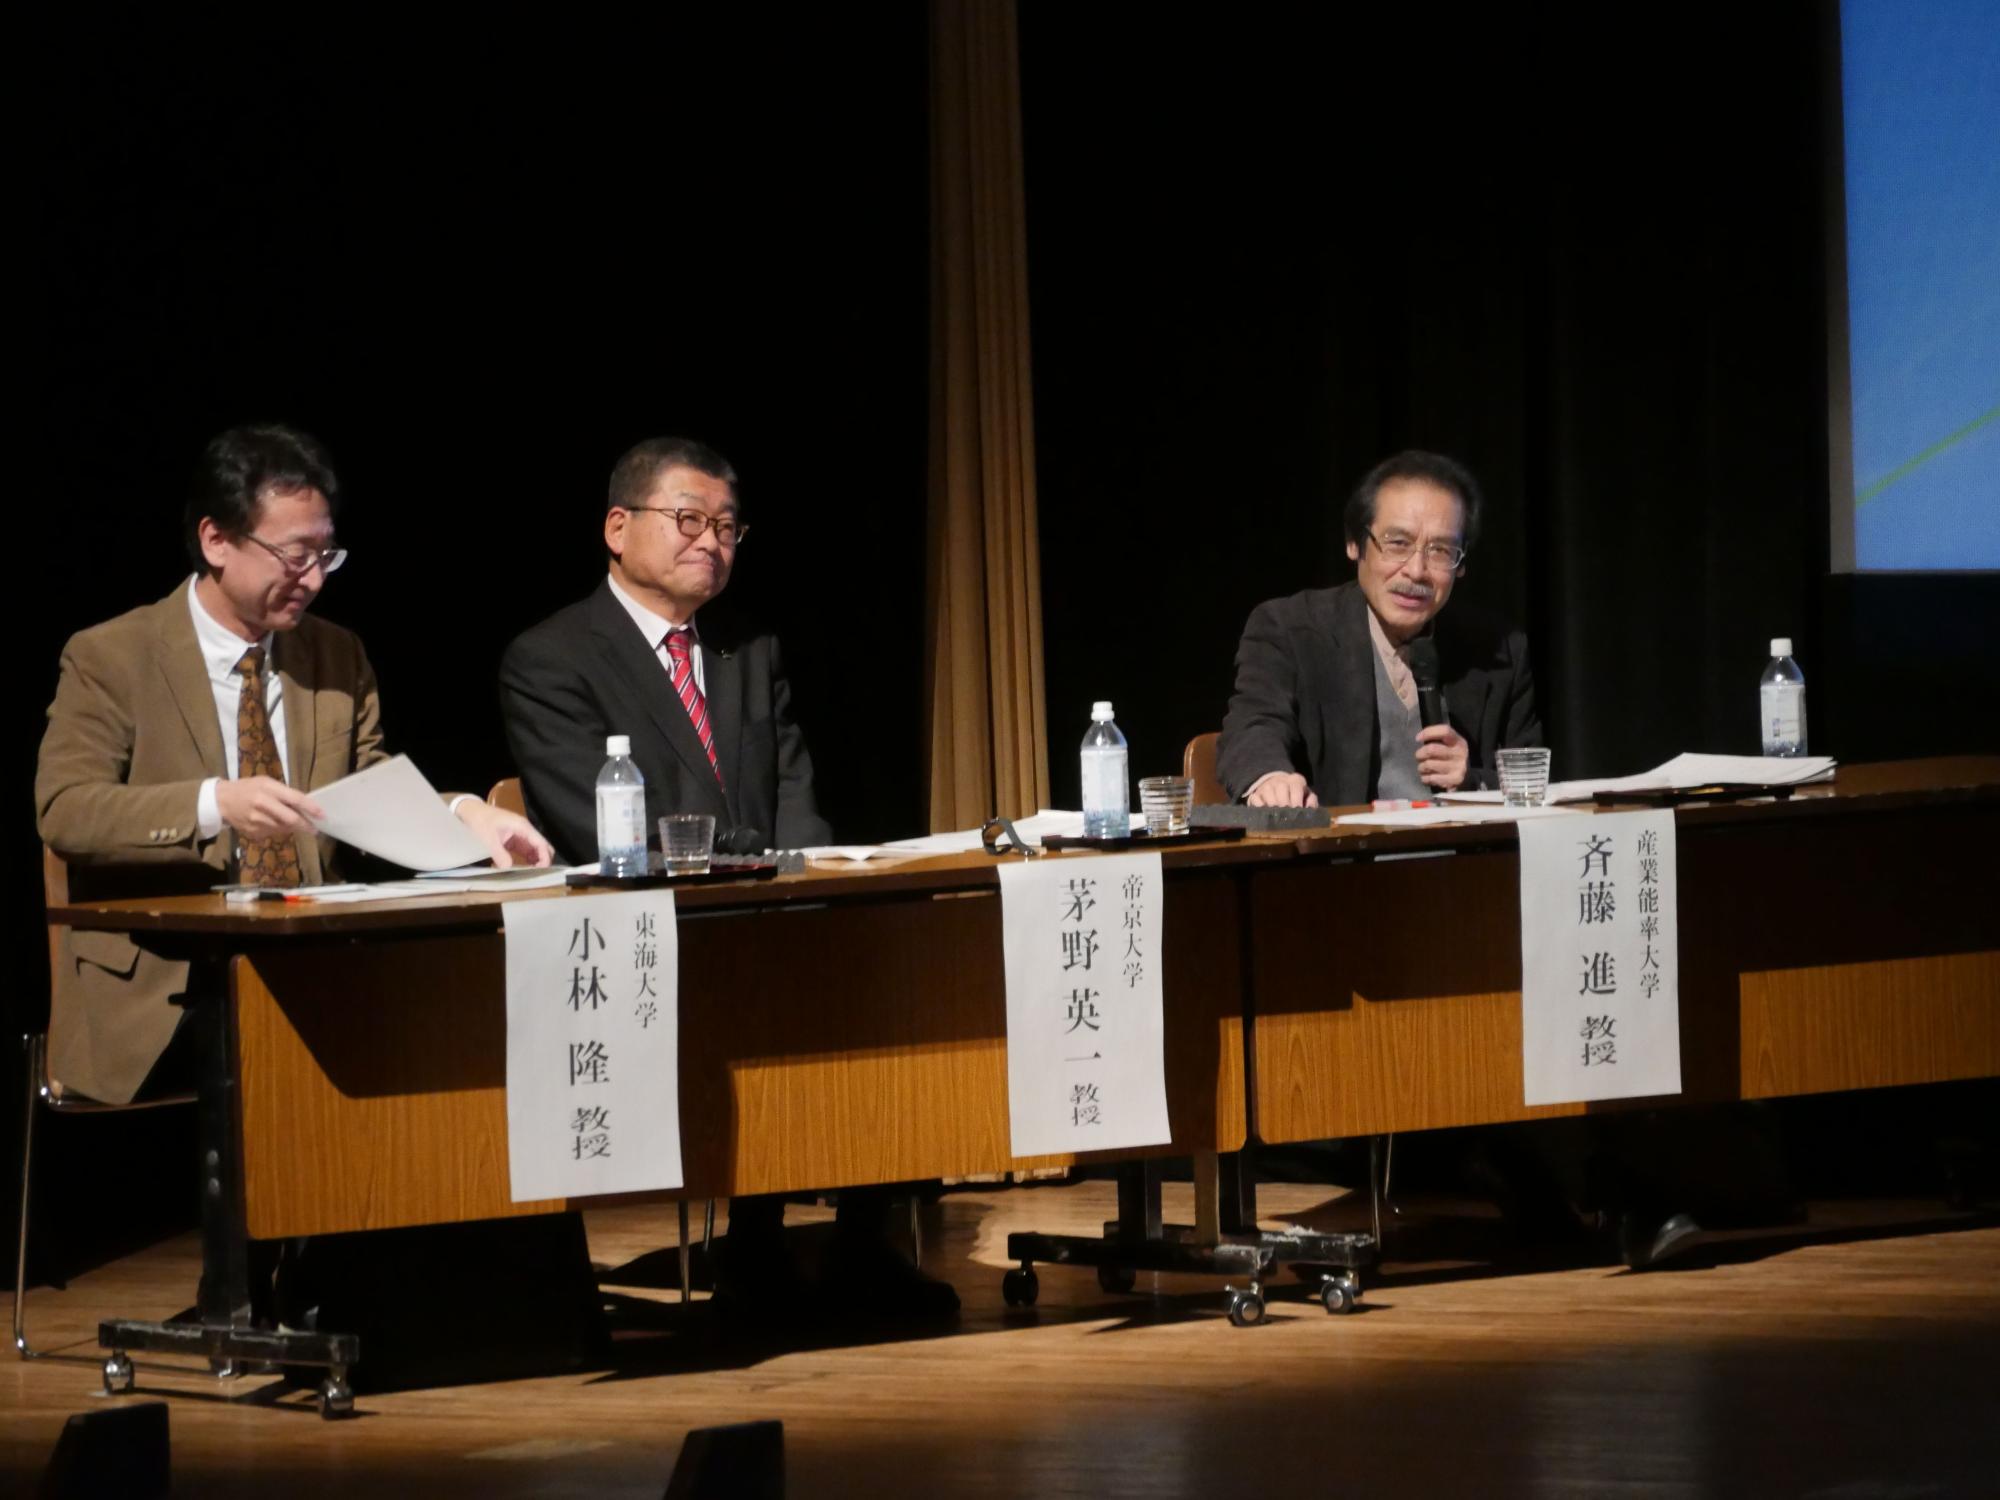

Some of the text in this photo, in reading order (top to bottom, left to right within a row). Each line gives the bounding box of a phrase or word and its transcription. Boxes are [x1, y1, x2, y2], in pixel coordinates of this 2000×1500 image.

[633, 911, 658, 1029] 東海大学
[1060, 877, 1101, 1127] 茅野 英一 教授
[1121, 873, 1144, 988] 帝京大学
[1577, 834, 1617, 1067] 斉藤 進 教授
[1637, 829, 1660, 999] 産業能率大学
[567, 917, 611, 1160] 小林 隆 教授
